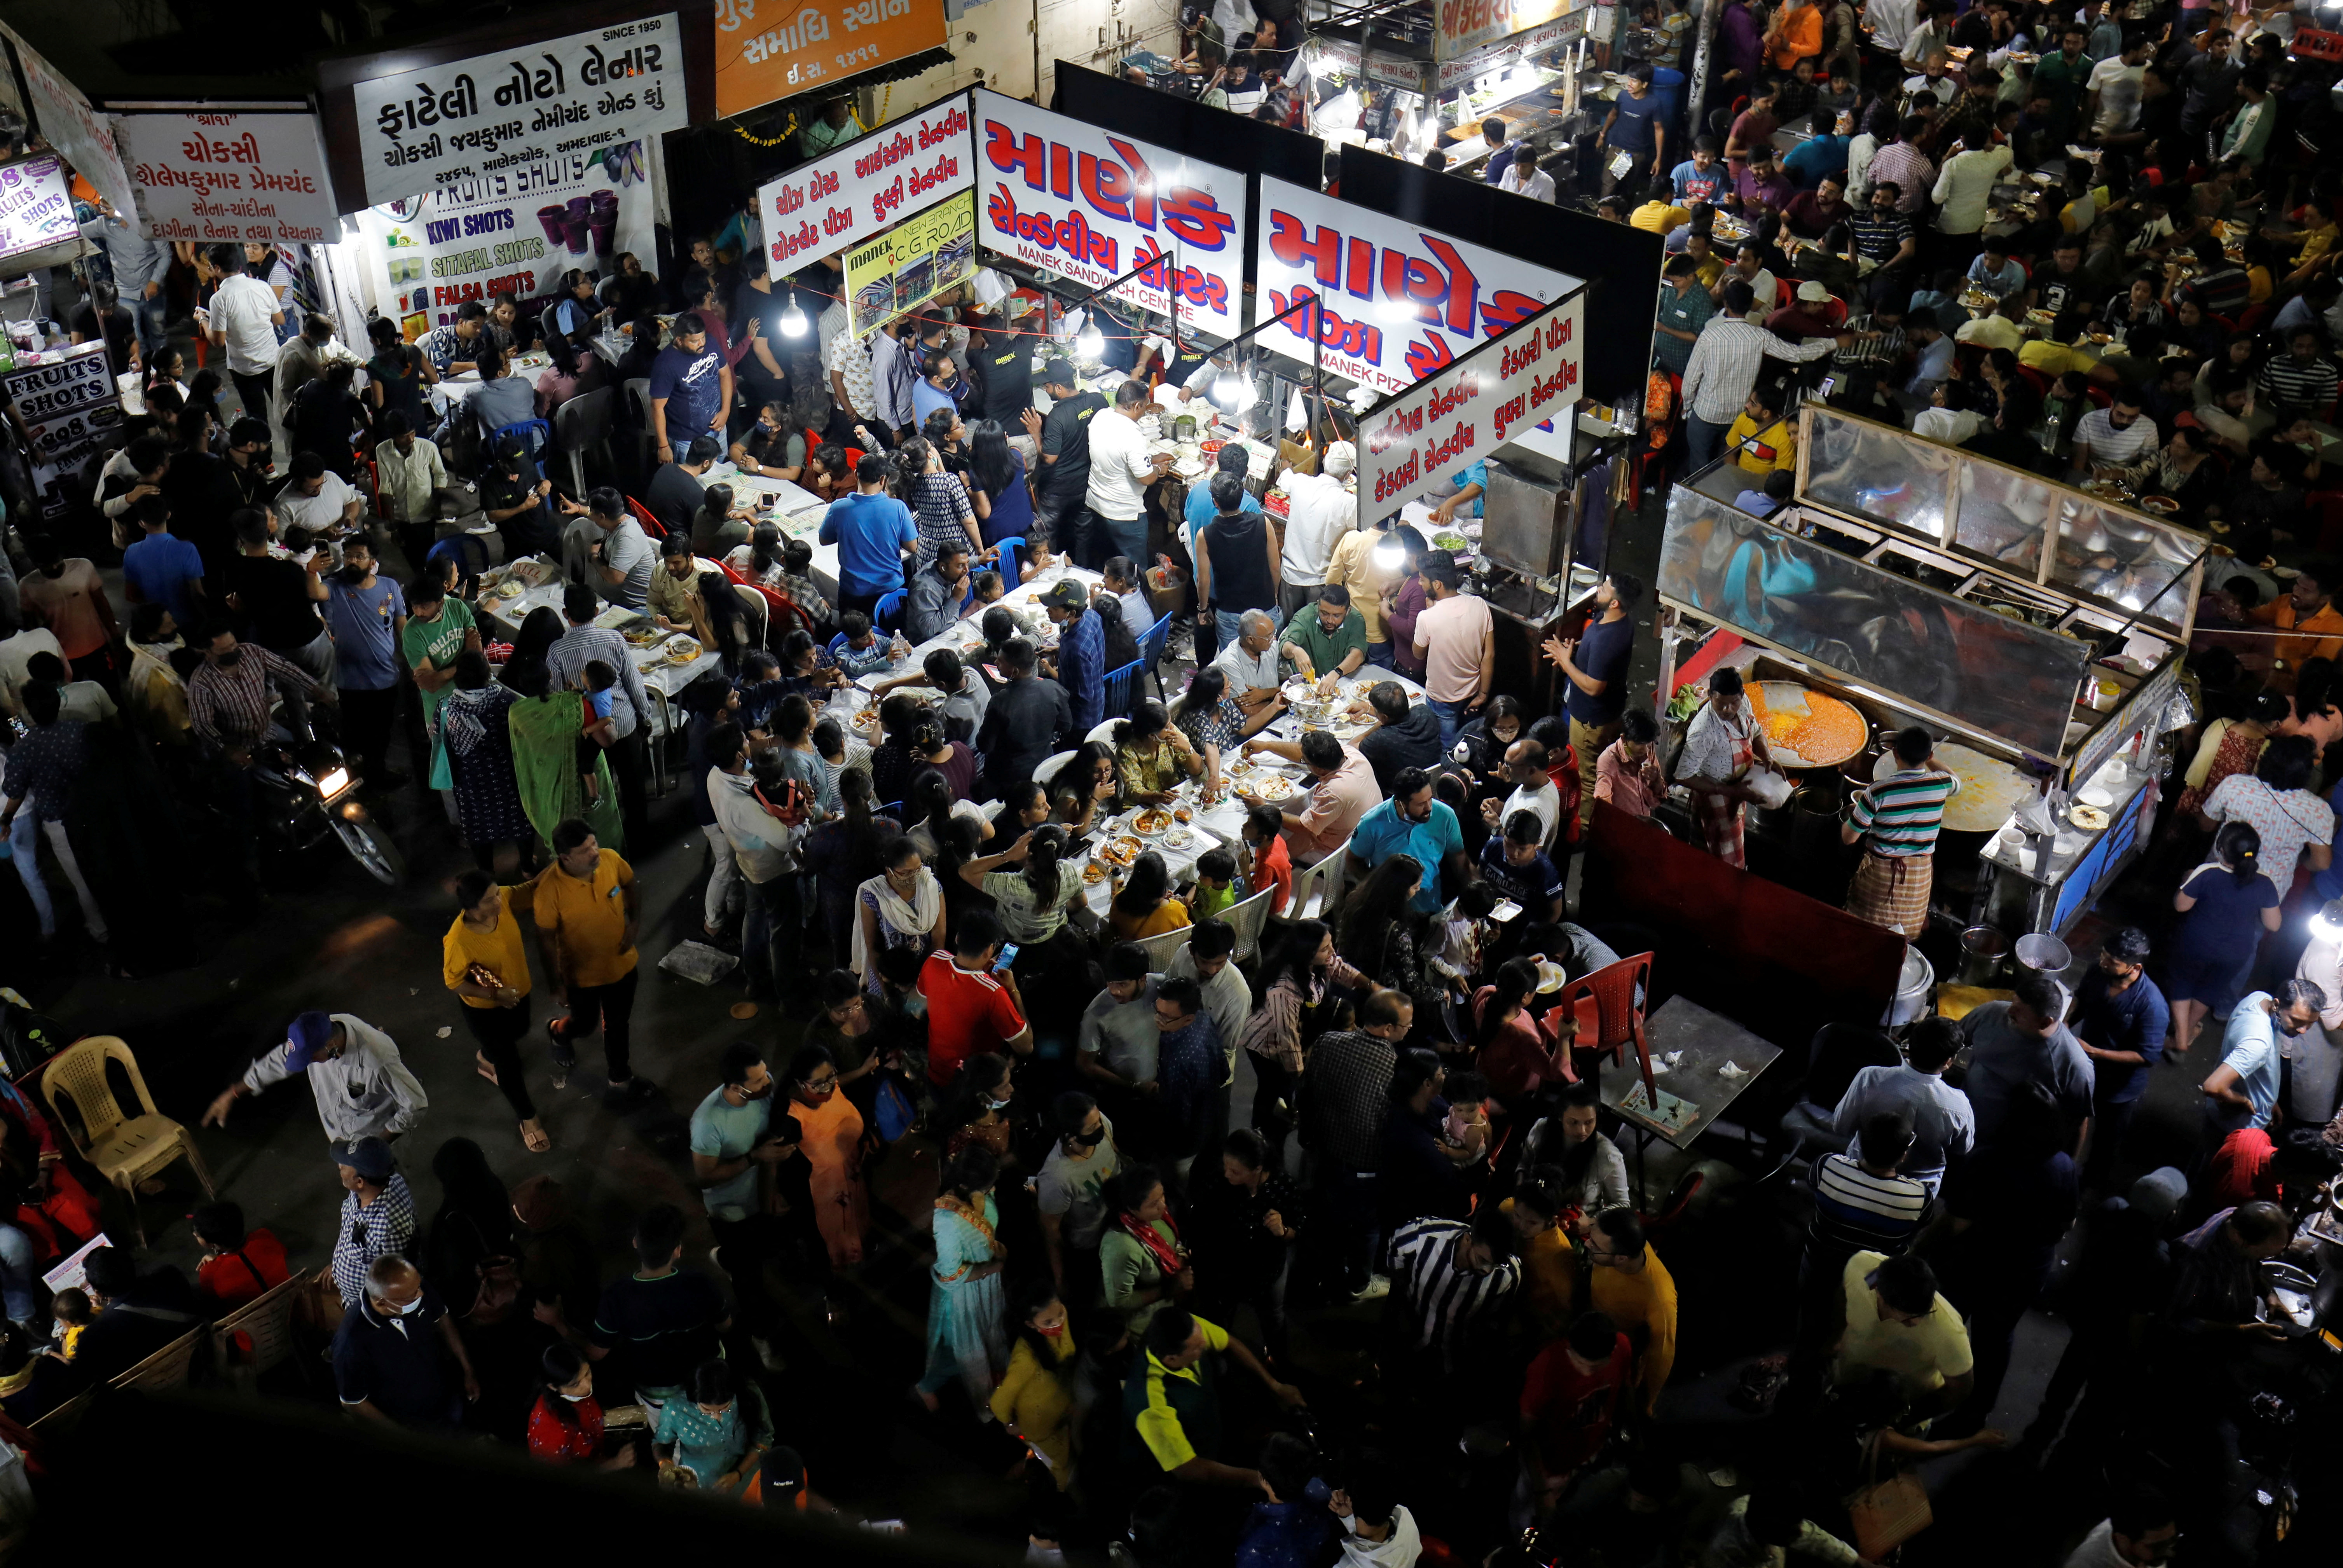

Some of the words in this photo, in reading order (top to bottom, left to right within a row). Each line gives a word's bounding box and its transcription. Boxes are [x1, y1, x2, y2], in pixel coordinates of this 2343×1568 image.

[602, 25, 637, 42] SINCE
[638, 20, 662, 36] 1950
[744, 8, 829, 64] સમાધિ
[843, 0, 910, 32] સ્થાન
[836, 44, 880, 68] ૧૪૧૧
[377, 74, 478, 140] ફાટેલી
[494, 55, 564, 107] નોટો
[581, 44, 662, 86] લેનાર
[182, 131, 261, 163] ચોકસી
[384, 133, 442, 167] ચોકસી
[450, 121, 524, 153] જયકુમાર
[532, 104, 590, 132] નેમીચંદ
[597, 92, 637, 115] એન્ડ
[482, 148, 549, 173] માણેકચોક,
[556, 128, 626, 155] અમદાવાદ-૧
[776, 184, 804, 217] ચીઝ
[810, 170, 840, 203] ટોસ્ટ
[918, 108, 968, 150] સેન્ડવીચ
[136, 163, 242, 196] શૈલેષકુમાર
[249, 166, 316, 194] પ્રેમચંદ
[985, 119, 1236, 252] માણેક
[21, 193, 63, 224] SHOTS
[192, 197, 276, 217] સોના-ચાંદીના
[772, 220, 820, 262] ચોકલેટ
[823, 207, 853, 237] પીઝા
[873, 175, 904, 223] કુલ્ફી
[909, 154, 958, 197] સેન્ડવીચ
[903, 218, 926, 238] NEW
[928, 195, 971, 226] BRANCH
[26, 243, 42, 251] types
[42, 237, 58, 246] Party
[58, 233, 77, 242] Orders
[152, 218, 198, 238] દાગીના
[204, 219, 239, 239] લેનાર
[246, 225, 272, 239] તથા
[278, 220, 324, 240] વેચનાર
[425, 218, 460, 245] KIWI
[464, 208, 514, 236] SHOTS
[927, 211, 972, 247] ROAD
[431, 245, 493, 278] SITAFAL
[496, 237, 545, 266] SHOTS
[850, 237, 894, 271] MANEK
[988, 182, 1118, 274] સેન્ડવીચ
[1133, 234, 1228, 316] સેન્ટર
[435, 282, 484, 307] FALSA
[487, 270, 536, 299] SHOTS
[1017, 243, 1062, 272] MANEK
[1139, 290, 1194, 321] CENTRE
[1269, 284, 1383, 367] પીઝા
[7, 356, 105, 397] FRUITS
[995, 351, 1016, 365] MANEK
[1428, 370, 1478, 423] સેન્ડવીચ
[1500, 327, 1541, 381] કેડબરી
[1546, 317, 1571, 351] પીઝા
[20, 379, 105, 418] SHOTS
[1377, 372, 1412, 393] PIZ
[1077, 406, 1094, 420] MANEK
[1375, 448, 1419, 503] કેડબરી
[1424, 421, 1474, 474] સેન્ડવીચ
[1530, 358, 1577, 409] સેન્ડવીચ
[428, 627, 464, 657] HOLLISTE
